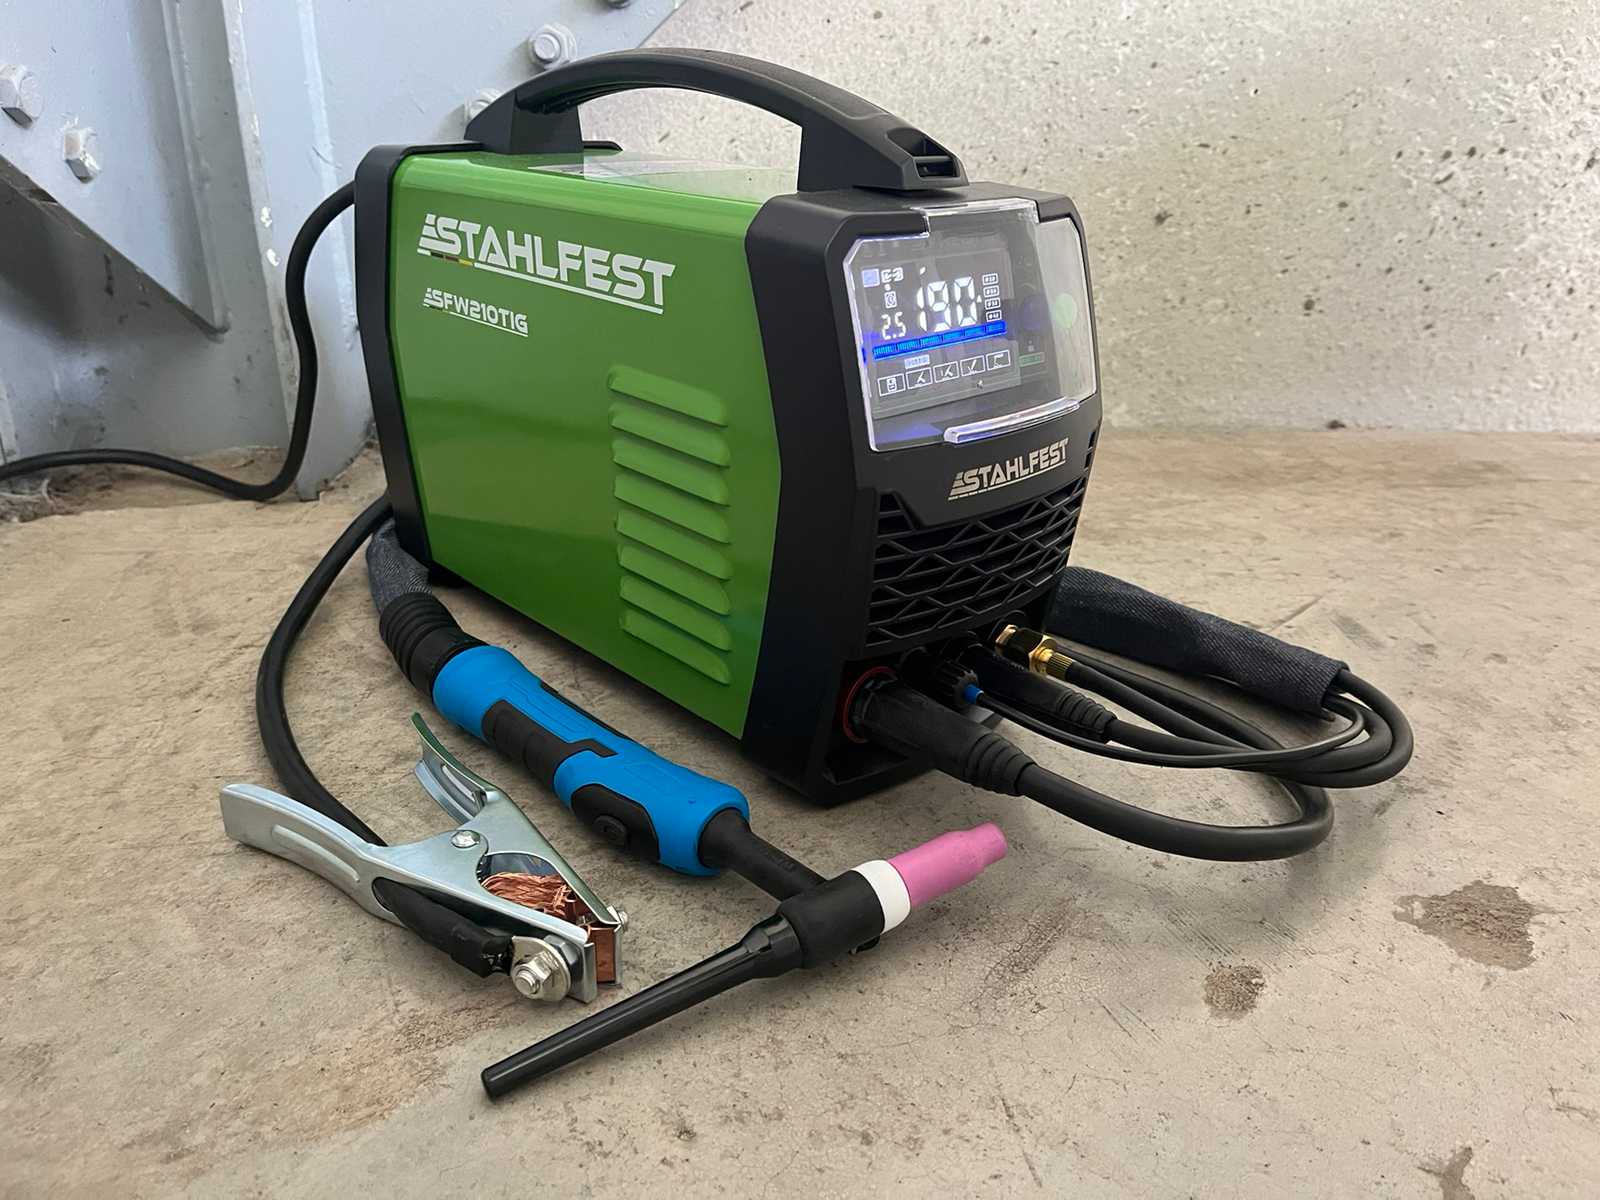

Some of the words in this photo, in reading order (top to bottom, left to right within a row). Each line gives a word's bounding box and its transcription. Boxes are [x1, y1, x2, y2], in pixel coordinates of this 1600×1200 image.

[418, 213, 676, 306] STAHLFEST
[424, 288, 529, 334] SFW210TIG
[917, 277, 977, 332] 190
[949, 437, 1069, 496] STAHLFEST
